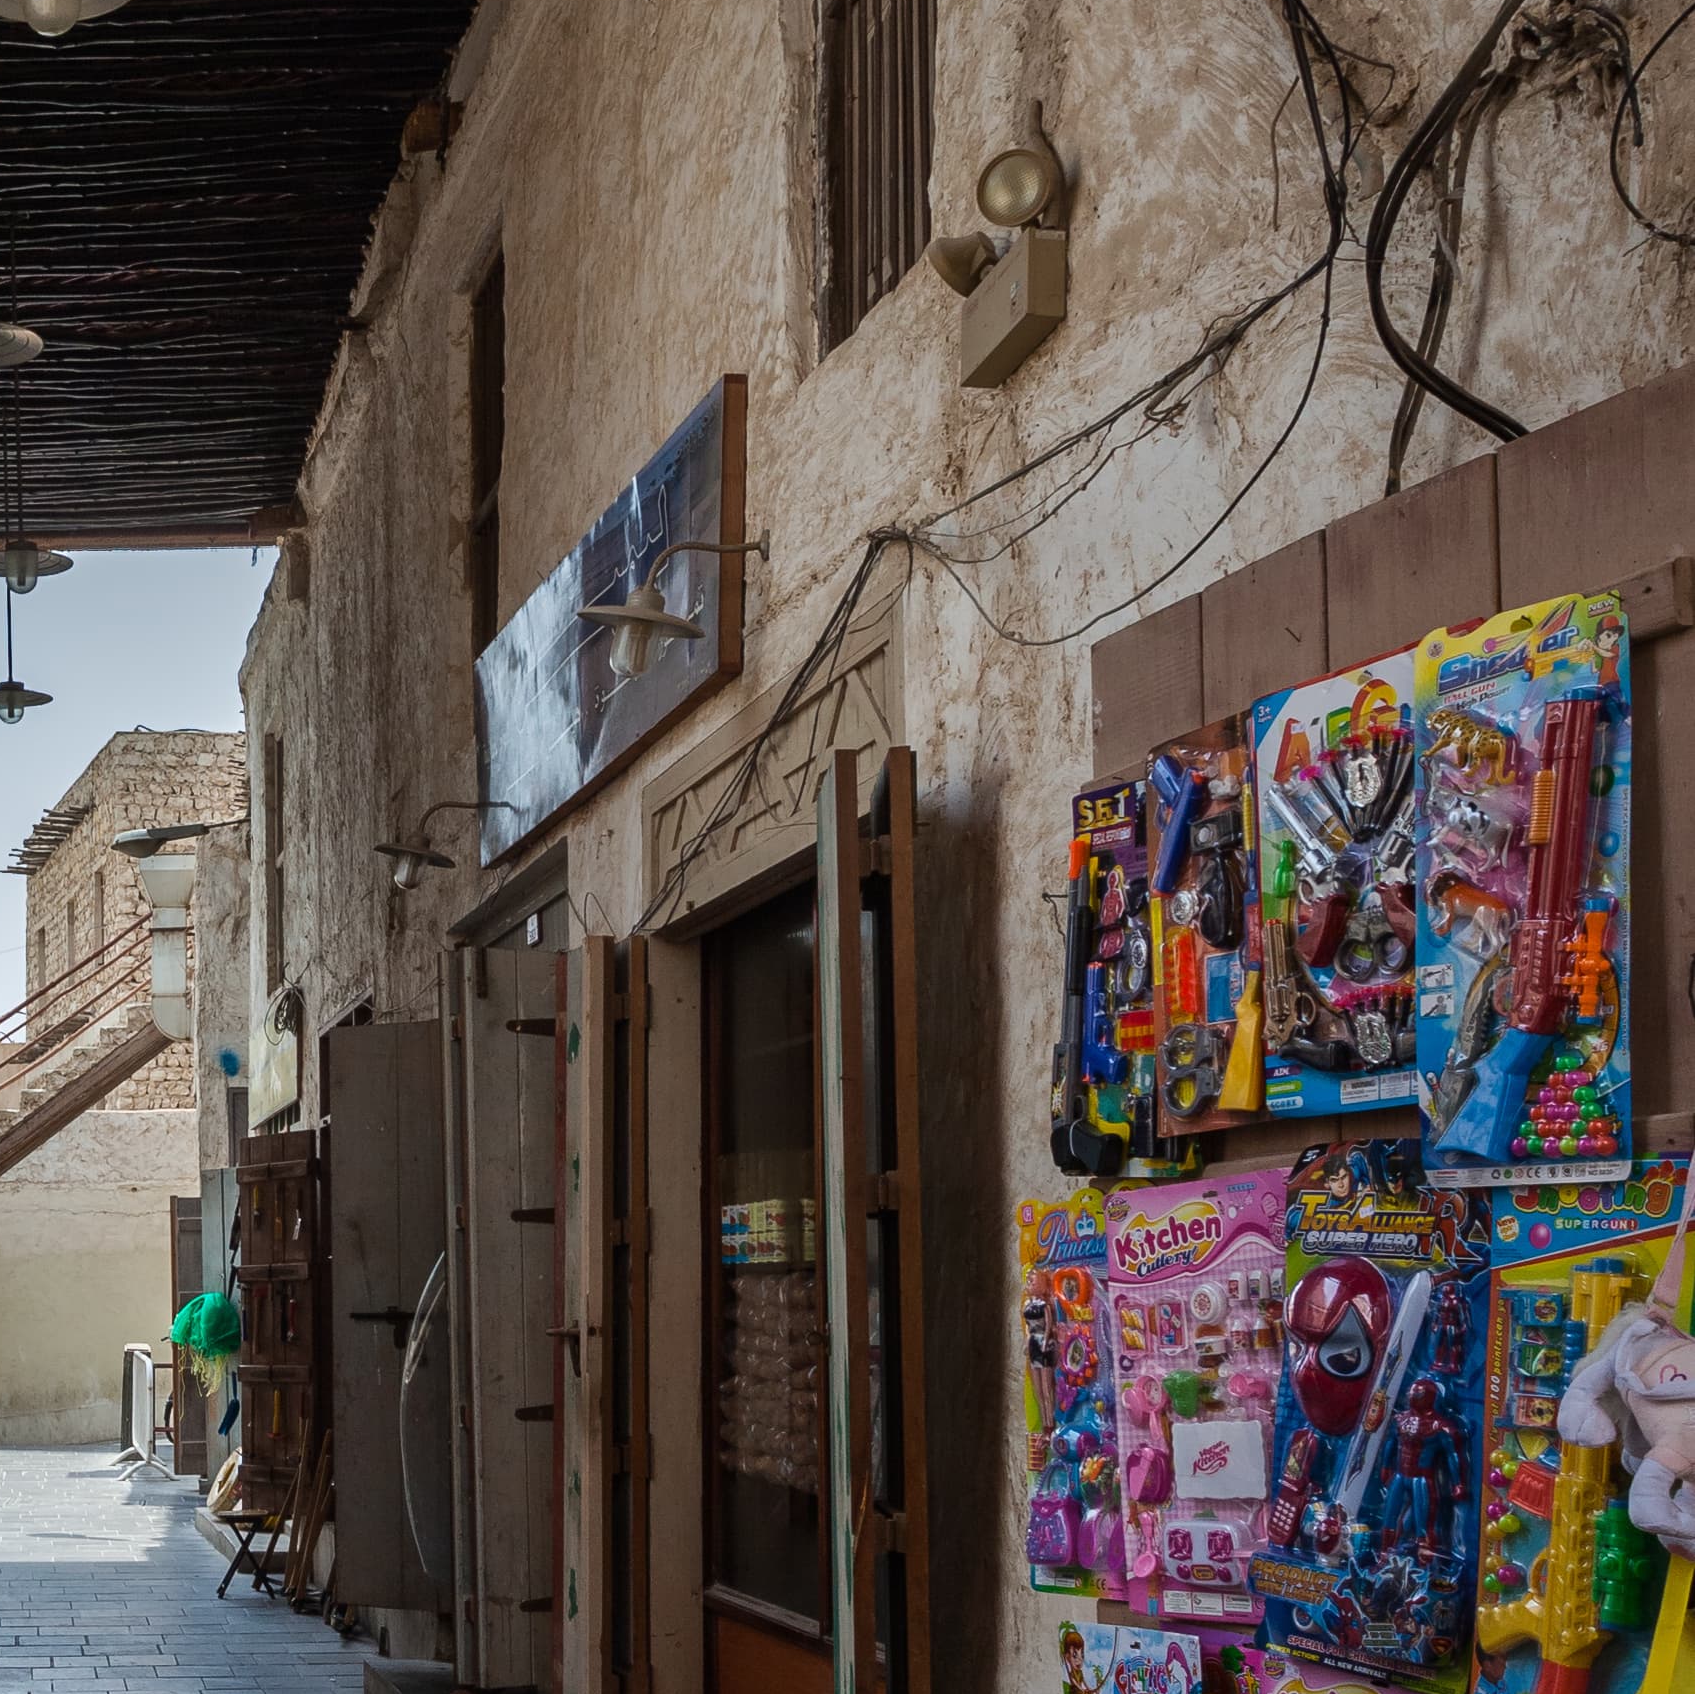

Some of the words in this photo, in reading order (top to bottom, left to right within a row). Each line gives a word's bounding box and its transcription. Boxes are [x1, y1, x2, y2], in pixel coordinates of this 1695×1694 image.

[1556, 1218, 1637, 1231] SUPERGUN!
[1114, 1215, 1222, 1267] Kitchen
[1306, 1231, 1369, 1250] SUPER
[1370, 1232, 1418, 1253] HERO
[1136, 1245, 1199, 1277] Cutlery!
[1287, 1635, 1325, 1652] SPECIAL
[1323, 1656, 1335, 1667] ALL
[1336, 1660, 1353, 1672] NEW
